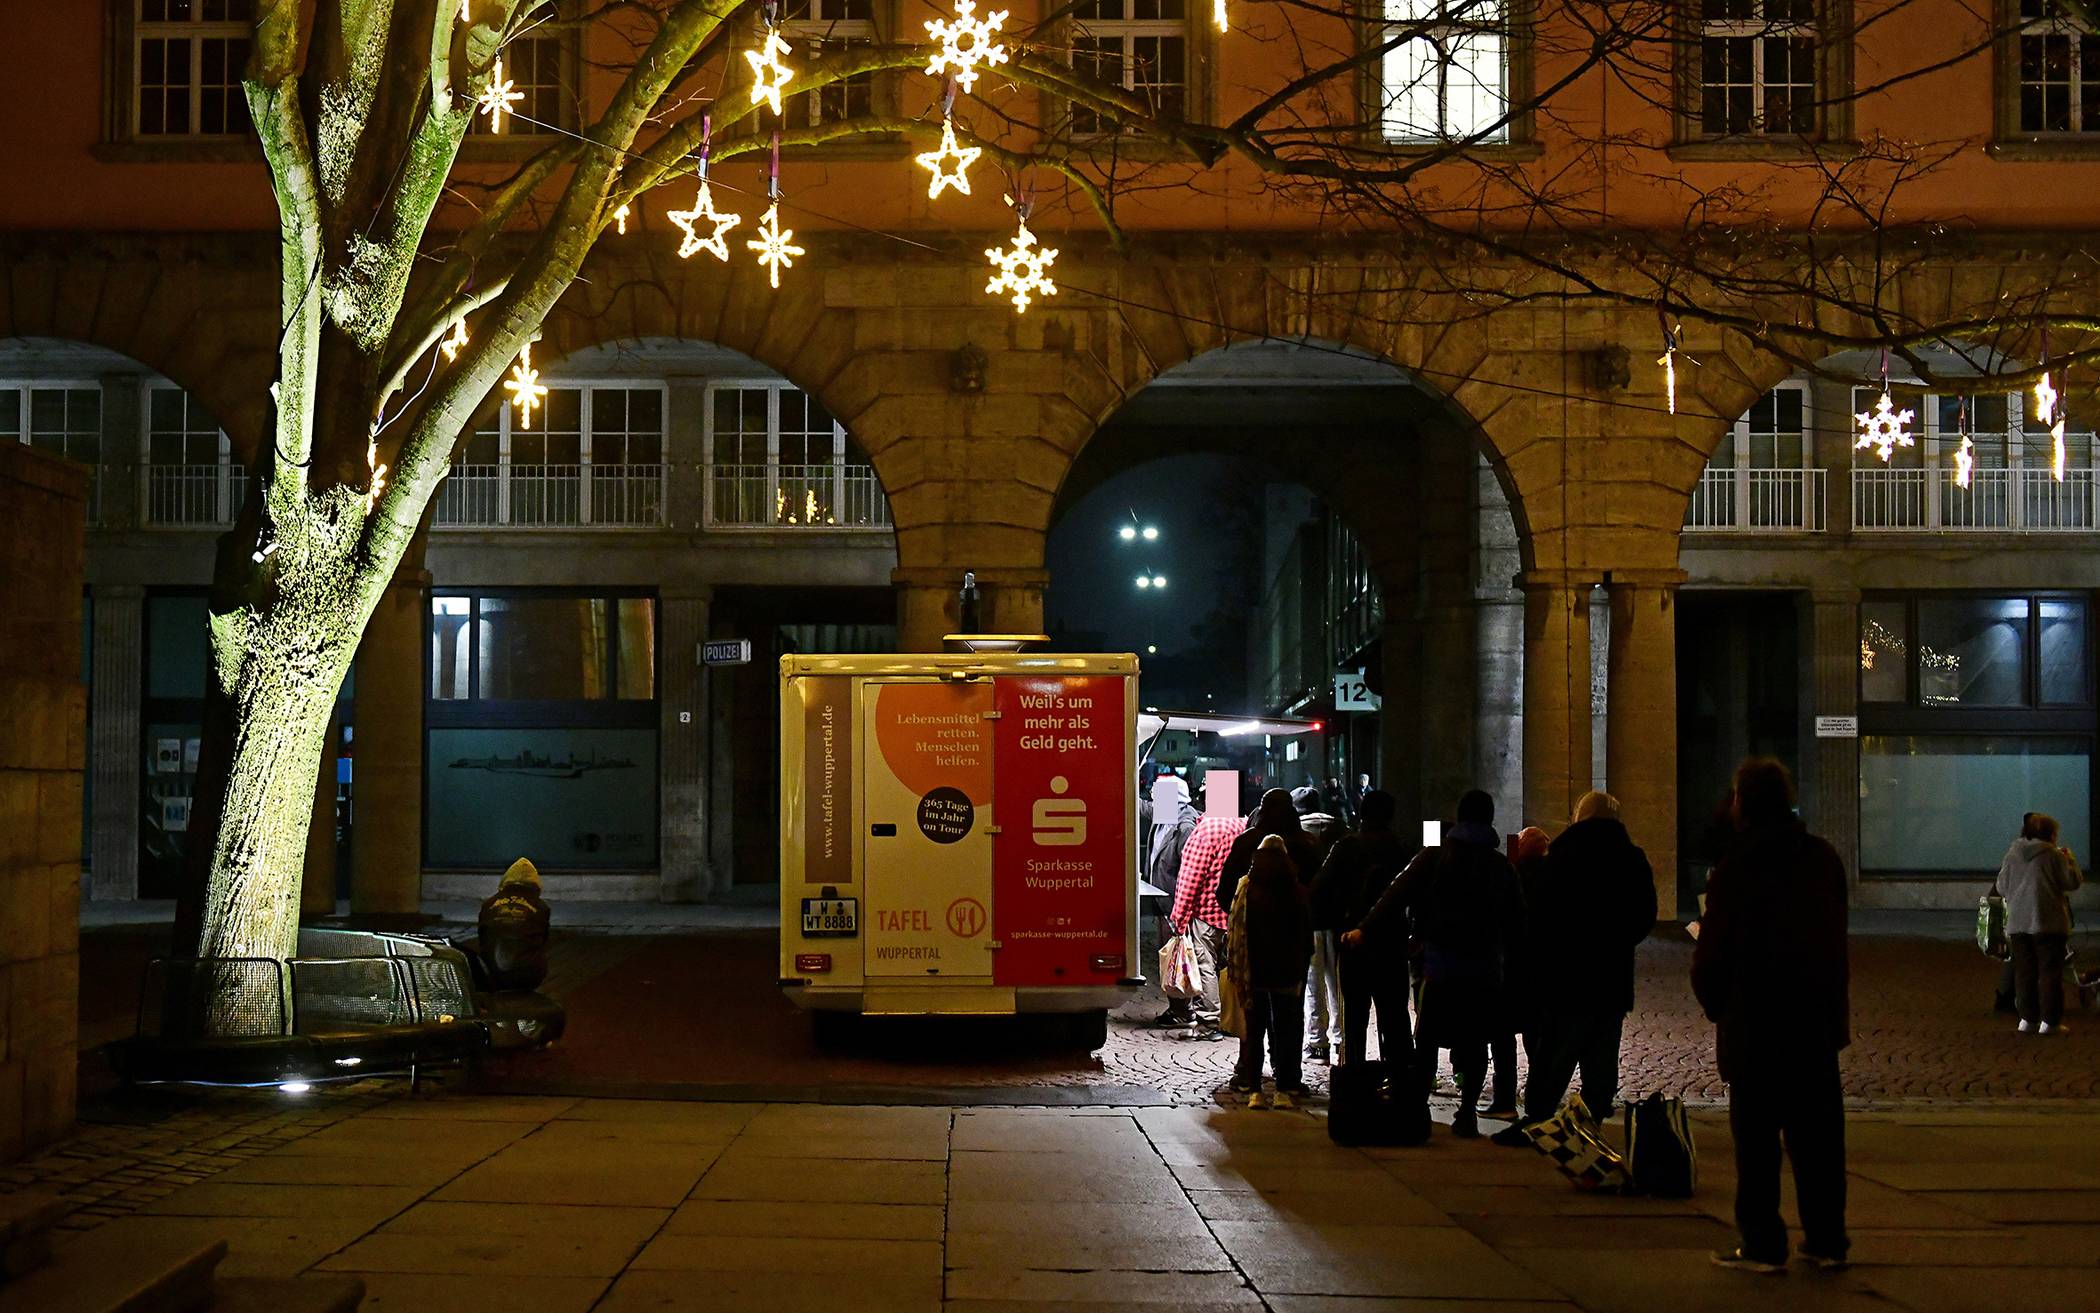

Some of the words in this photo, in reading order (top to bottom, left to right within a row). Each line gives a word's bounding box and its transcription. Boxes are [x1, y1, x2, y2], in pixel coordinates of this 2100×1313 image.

[706, 644, 740, 660] POLIZEI
[1339, 682, 1367, 702] 12
[1020, 694, 1065, 709] Weil's
[1068, 697, 1093, 709] um
[897, 713, 980, 724] Lebensmittel
[1024, 714, 1064, 729] mehr
[1068, 714, 1090, 729] als
[936, 728, 980, 738] retten.
[915, 742, 980, 752] Menschen
[1020, 735, 1054, 750] Geld
[1057, 734, 1098, 753] geht.
[936, 755, 980, 766] helfen.
[822, 705, 834, 858] www.tafel-wuppertal.de
[924, 799, 943, 809] 365
[945, 800, 969, 812] Tage
[925, 809, 939, 819] im
[940, 812, 966, 823] Jahr
[923, 823, 937, 831] on
[939, 823, 964, 835] Tour
[1026, 858, 1093, 874] Sparkasse
[1025, 875, 1094, 891] Wuppertal
[820, 902, 829, 915] W
[806, 916, 822, 929] WT
[824, 915, 853, 929] 8888
[877, 910, 932, 931] TAFEL
[1010, 930, 1109, 940] sparkasse-wuppertal.de
[876, 947, 942, 960] WUPPERTAL
